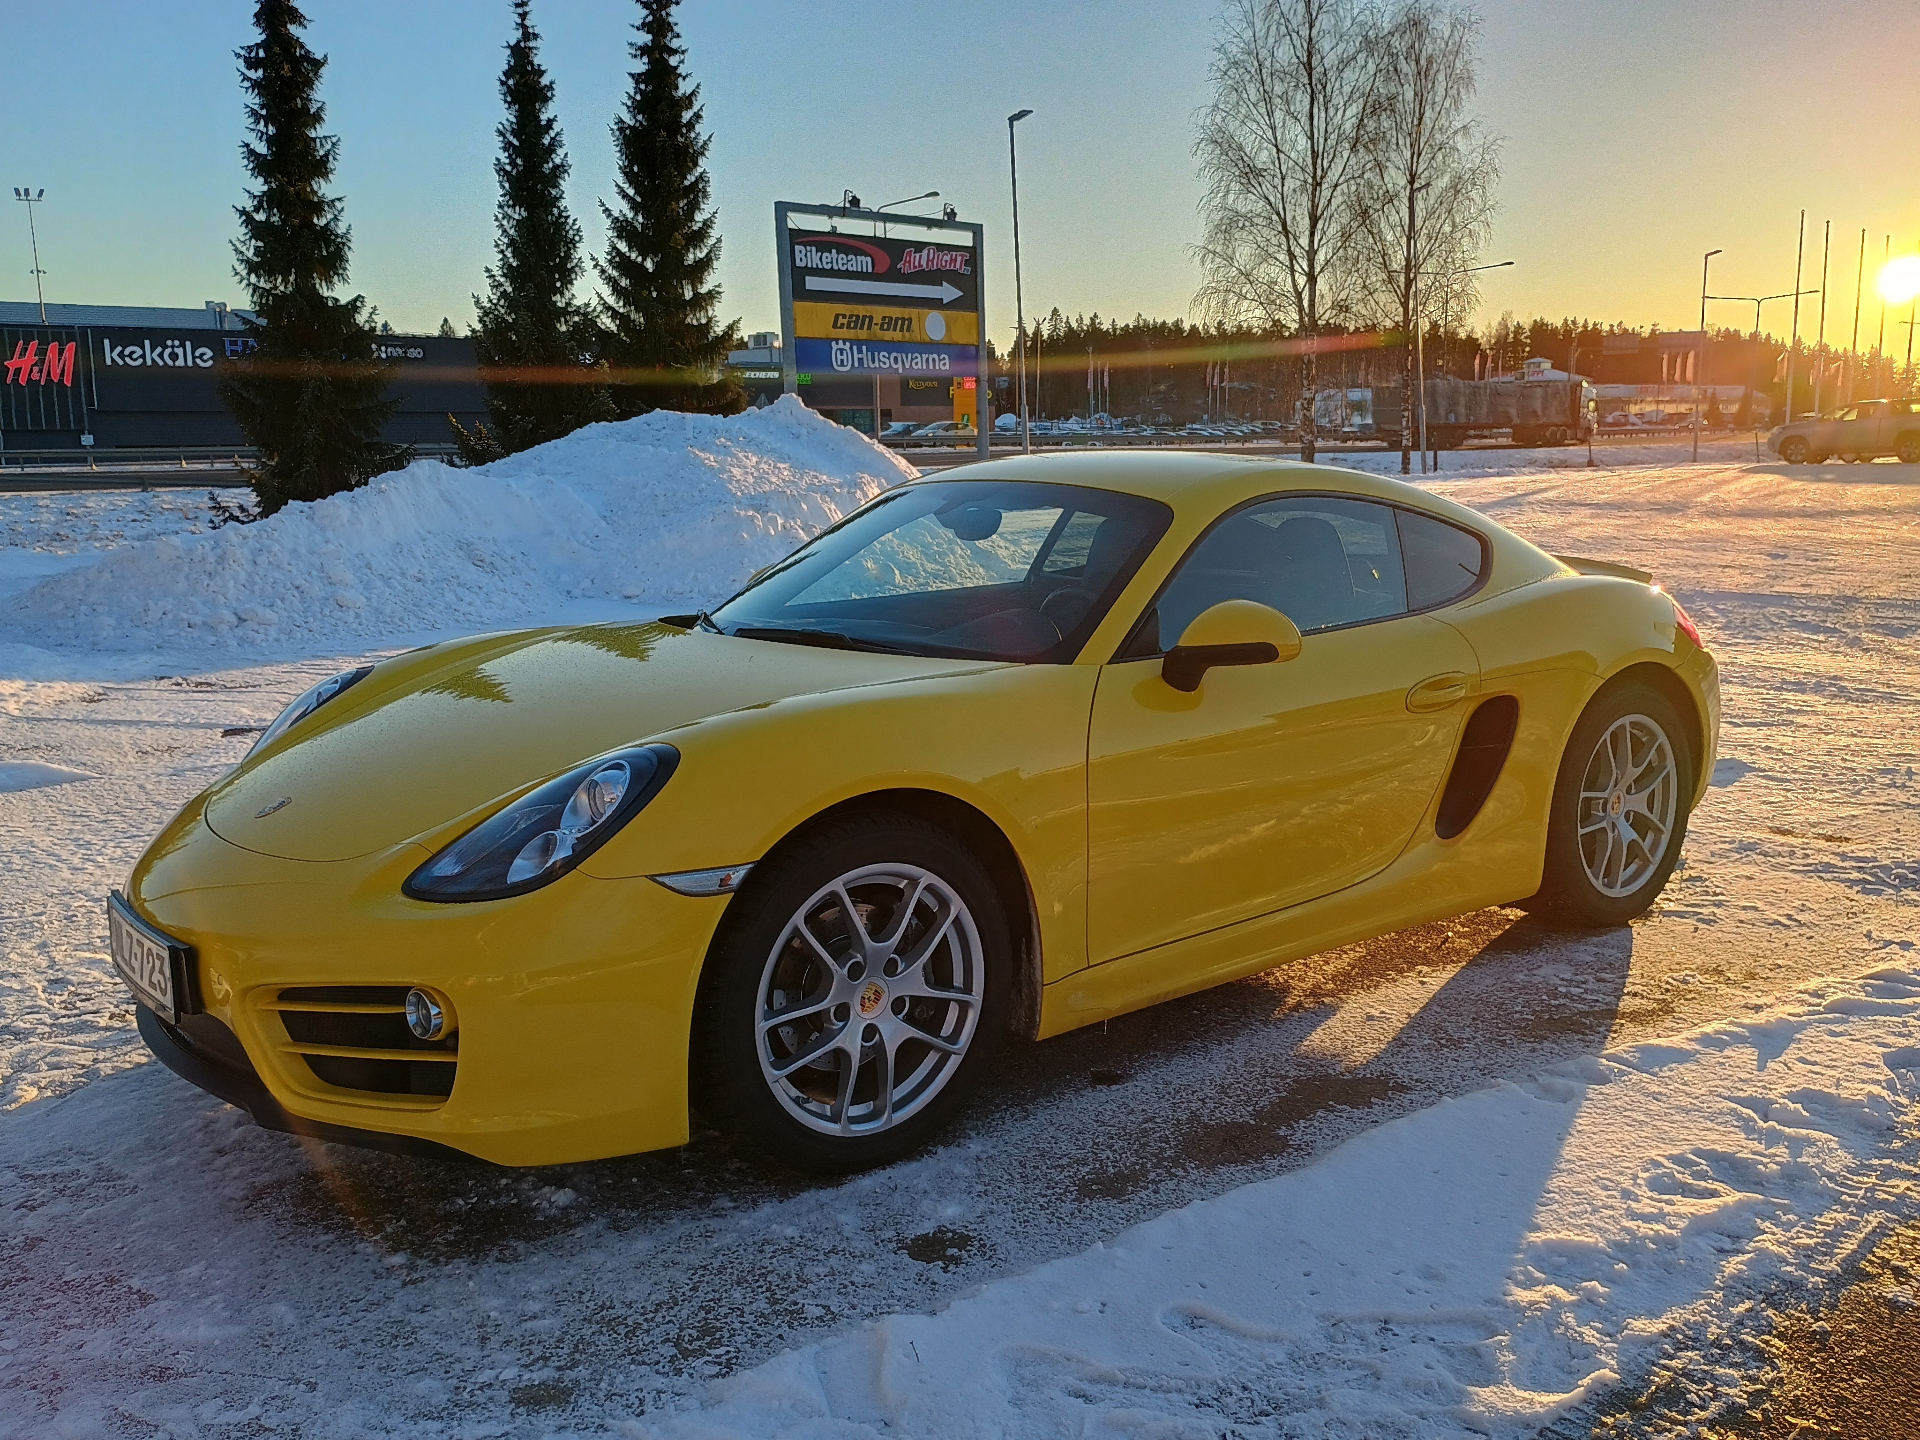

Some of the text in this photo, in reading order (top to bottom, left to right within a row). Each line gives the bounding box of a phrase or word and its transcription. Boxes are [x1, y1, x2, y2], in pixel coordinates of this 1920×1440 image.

[794, 245, 873, 273] Biketeam
[831, 312, 913, 333] can-am
[4, 340, 76, 387] H&M
[103, 338, 214, 368] kekäle
[852, 345, 950, 373] Husqvarna
[742, 371, 780, 379] ECHERS
